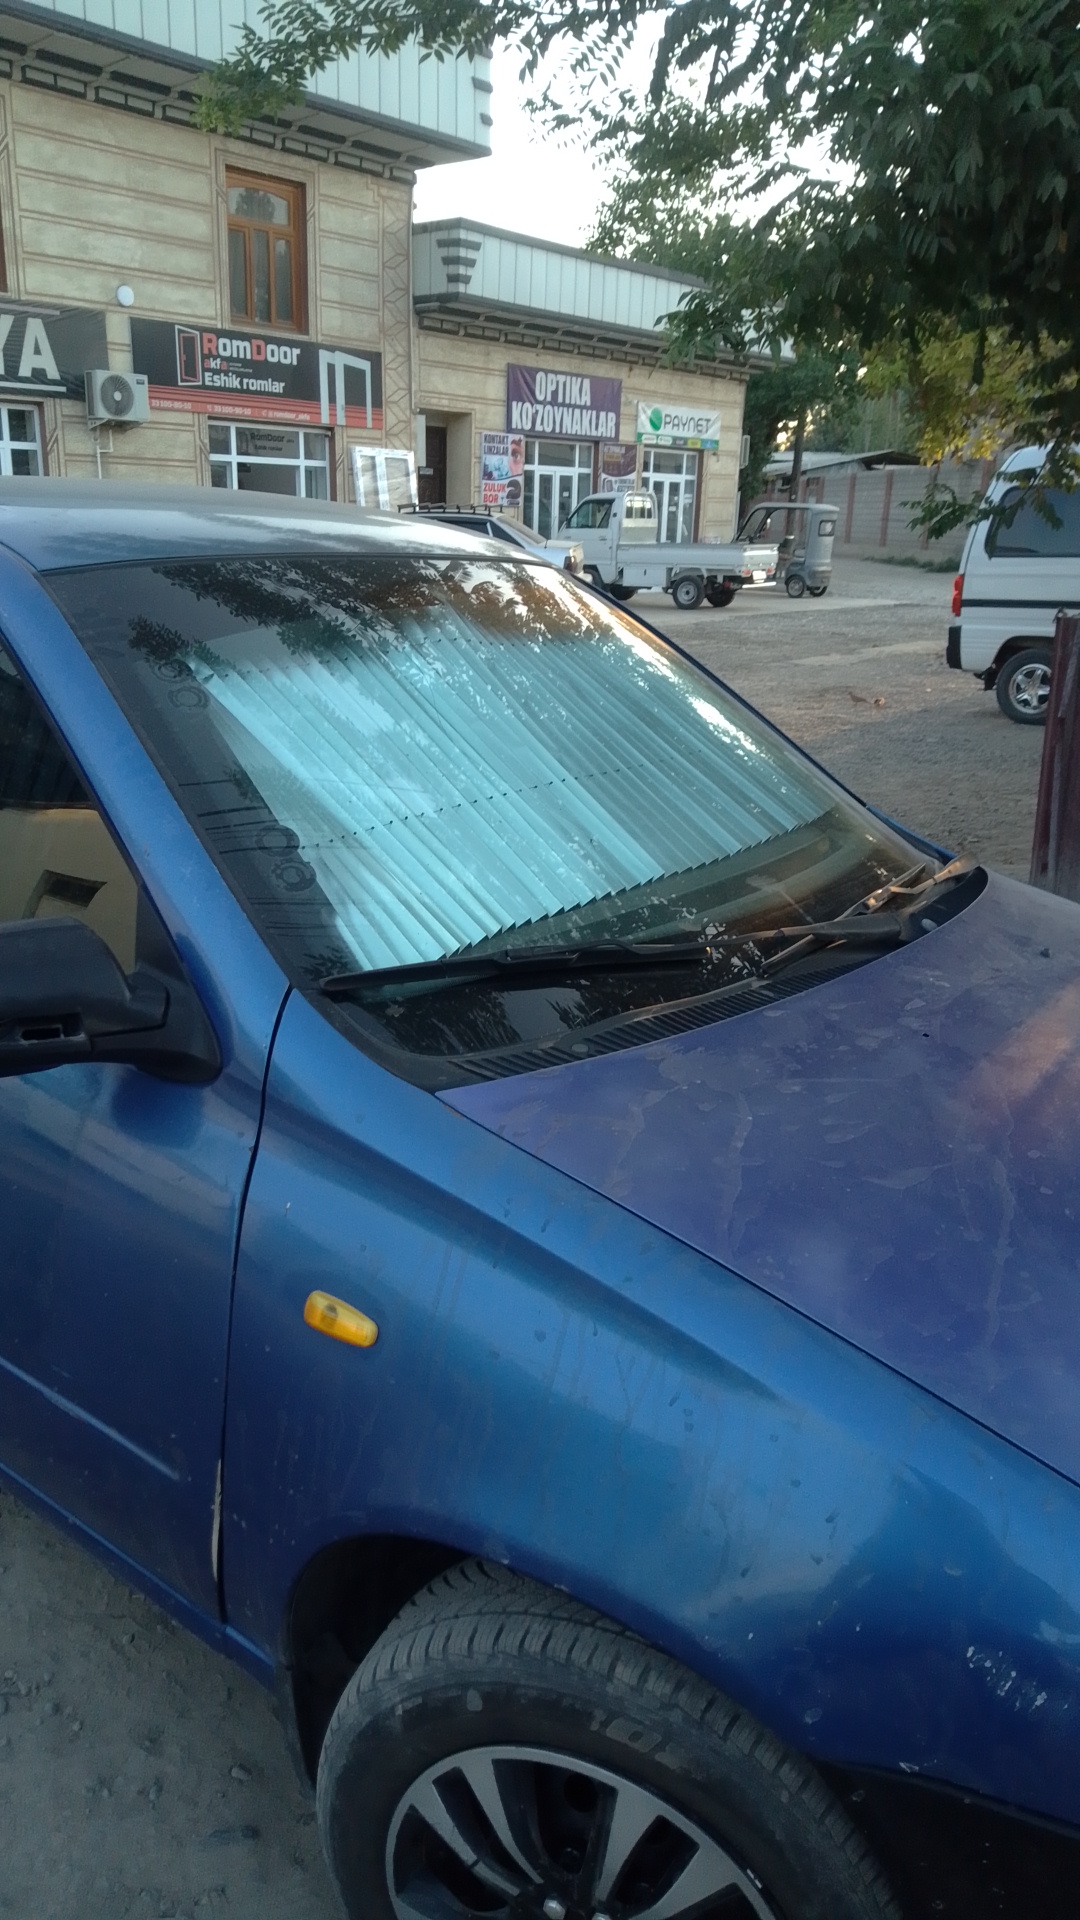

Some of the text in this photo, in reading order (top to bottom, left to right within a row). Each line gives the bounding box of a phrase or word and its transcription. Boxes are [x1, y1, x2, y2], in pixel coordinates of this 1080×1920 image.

[202, 332, 301, 366] RomDoor
[204, 357, 228, 371] akfa
[204, 371, 286, 394] Eshik romlar
[535, 371, 591, 407] OPTIKA
[663, 413, 712, 434] PAYNET
[483, 433, 509, 446] KONTAKT
[483, 444, 509, 457] LINZALAR
[483, 482, 507, 493] ZULUK
[483, 493, 499, 504] BOR
